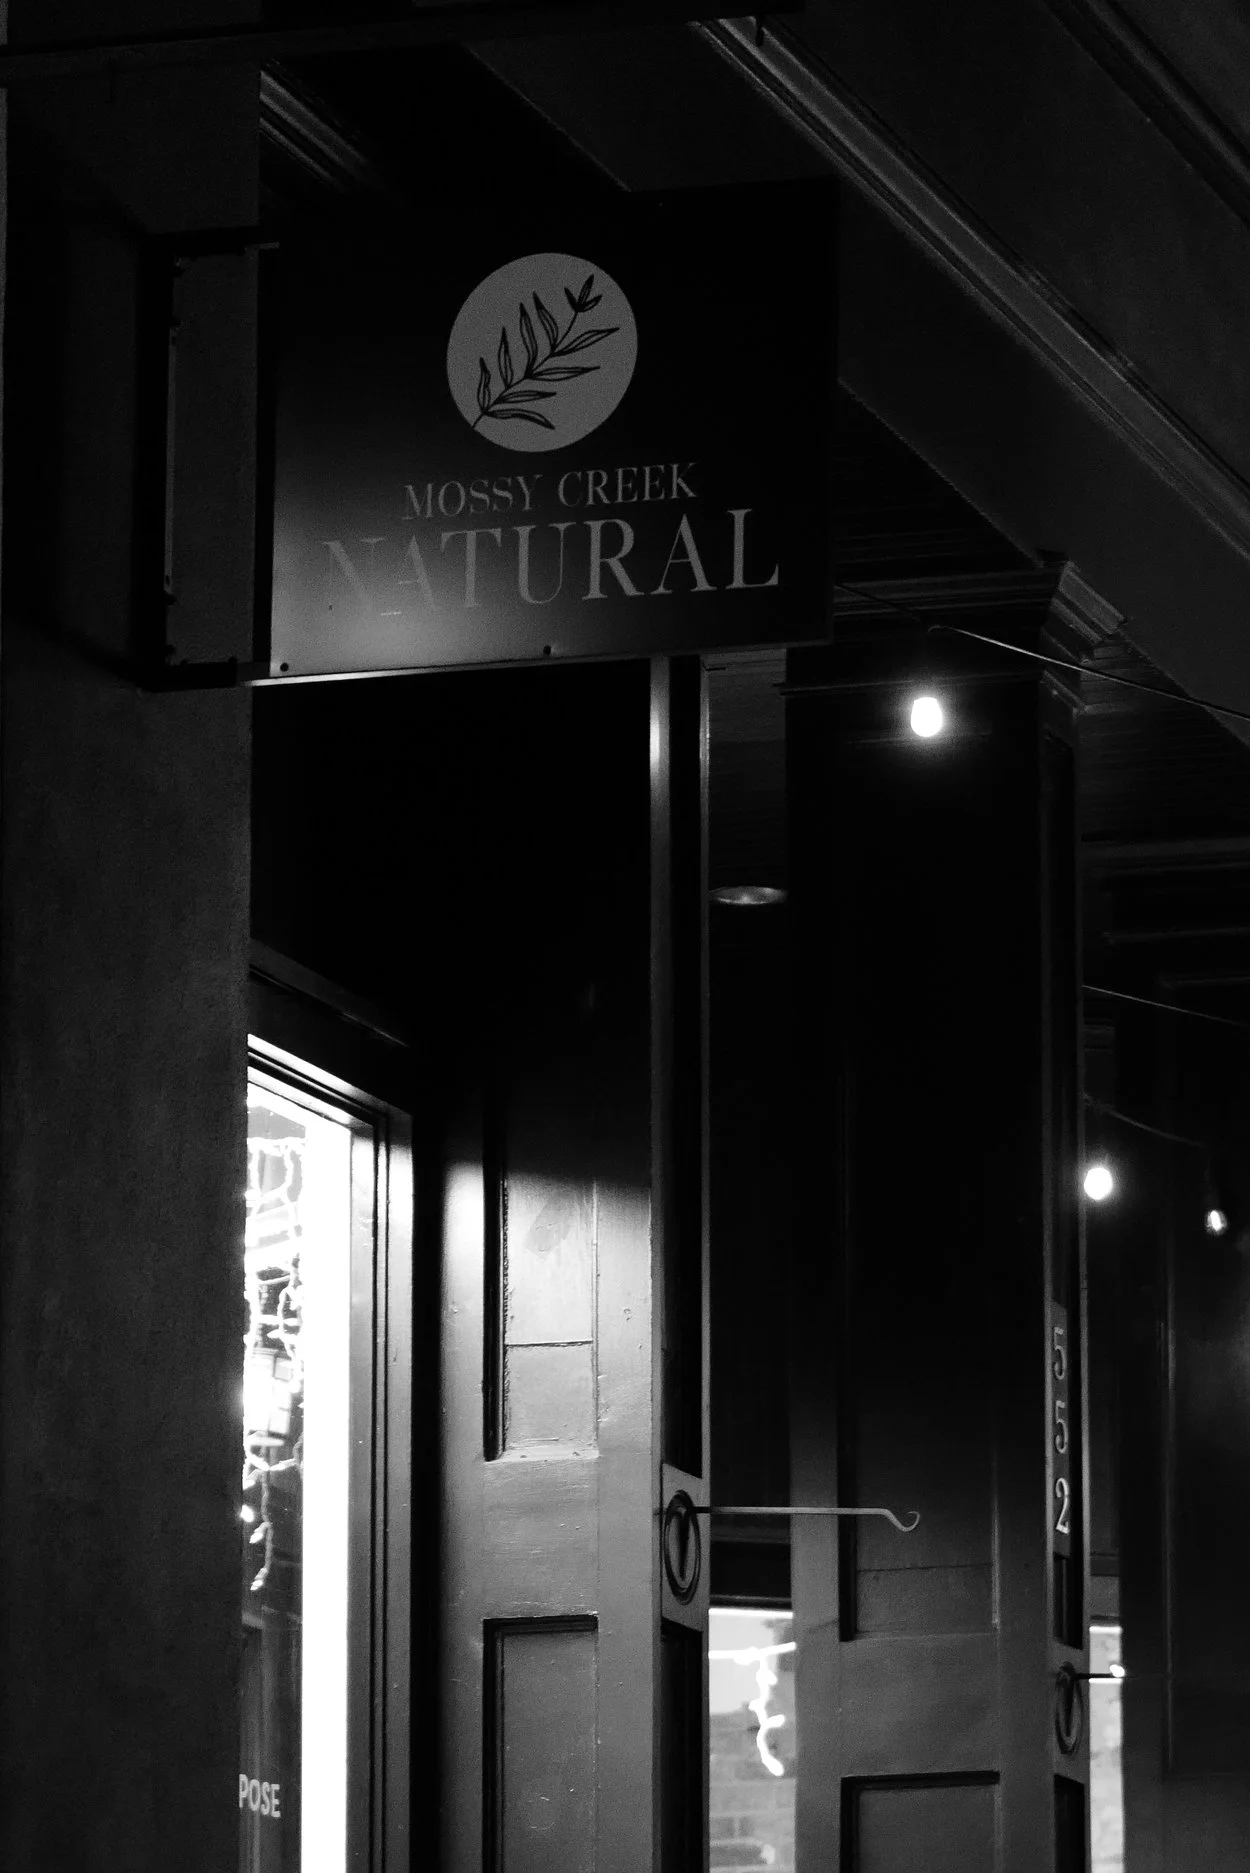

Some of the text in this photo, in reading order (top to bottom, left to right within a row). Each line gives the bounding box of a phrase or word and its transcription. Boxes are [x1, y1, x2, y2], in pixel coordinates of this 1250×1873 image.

[403, 463, 700, 521] MOSSY CREEK
[322, 507, 780, 617] NATURAL
[1053, 1326, 1071, 1535] 552
[238, 1773, 281, 1818] POSE
